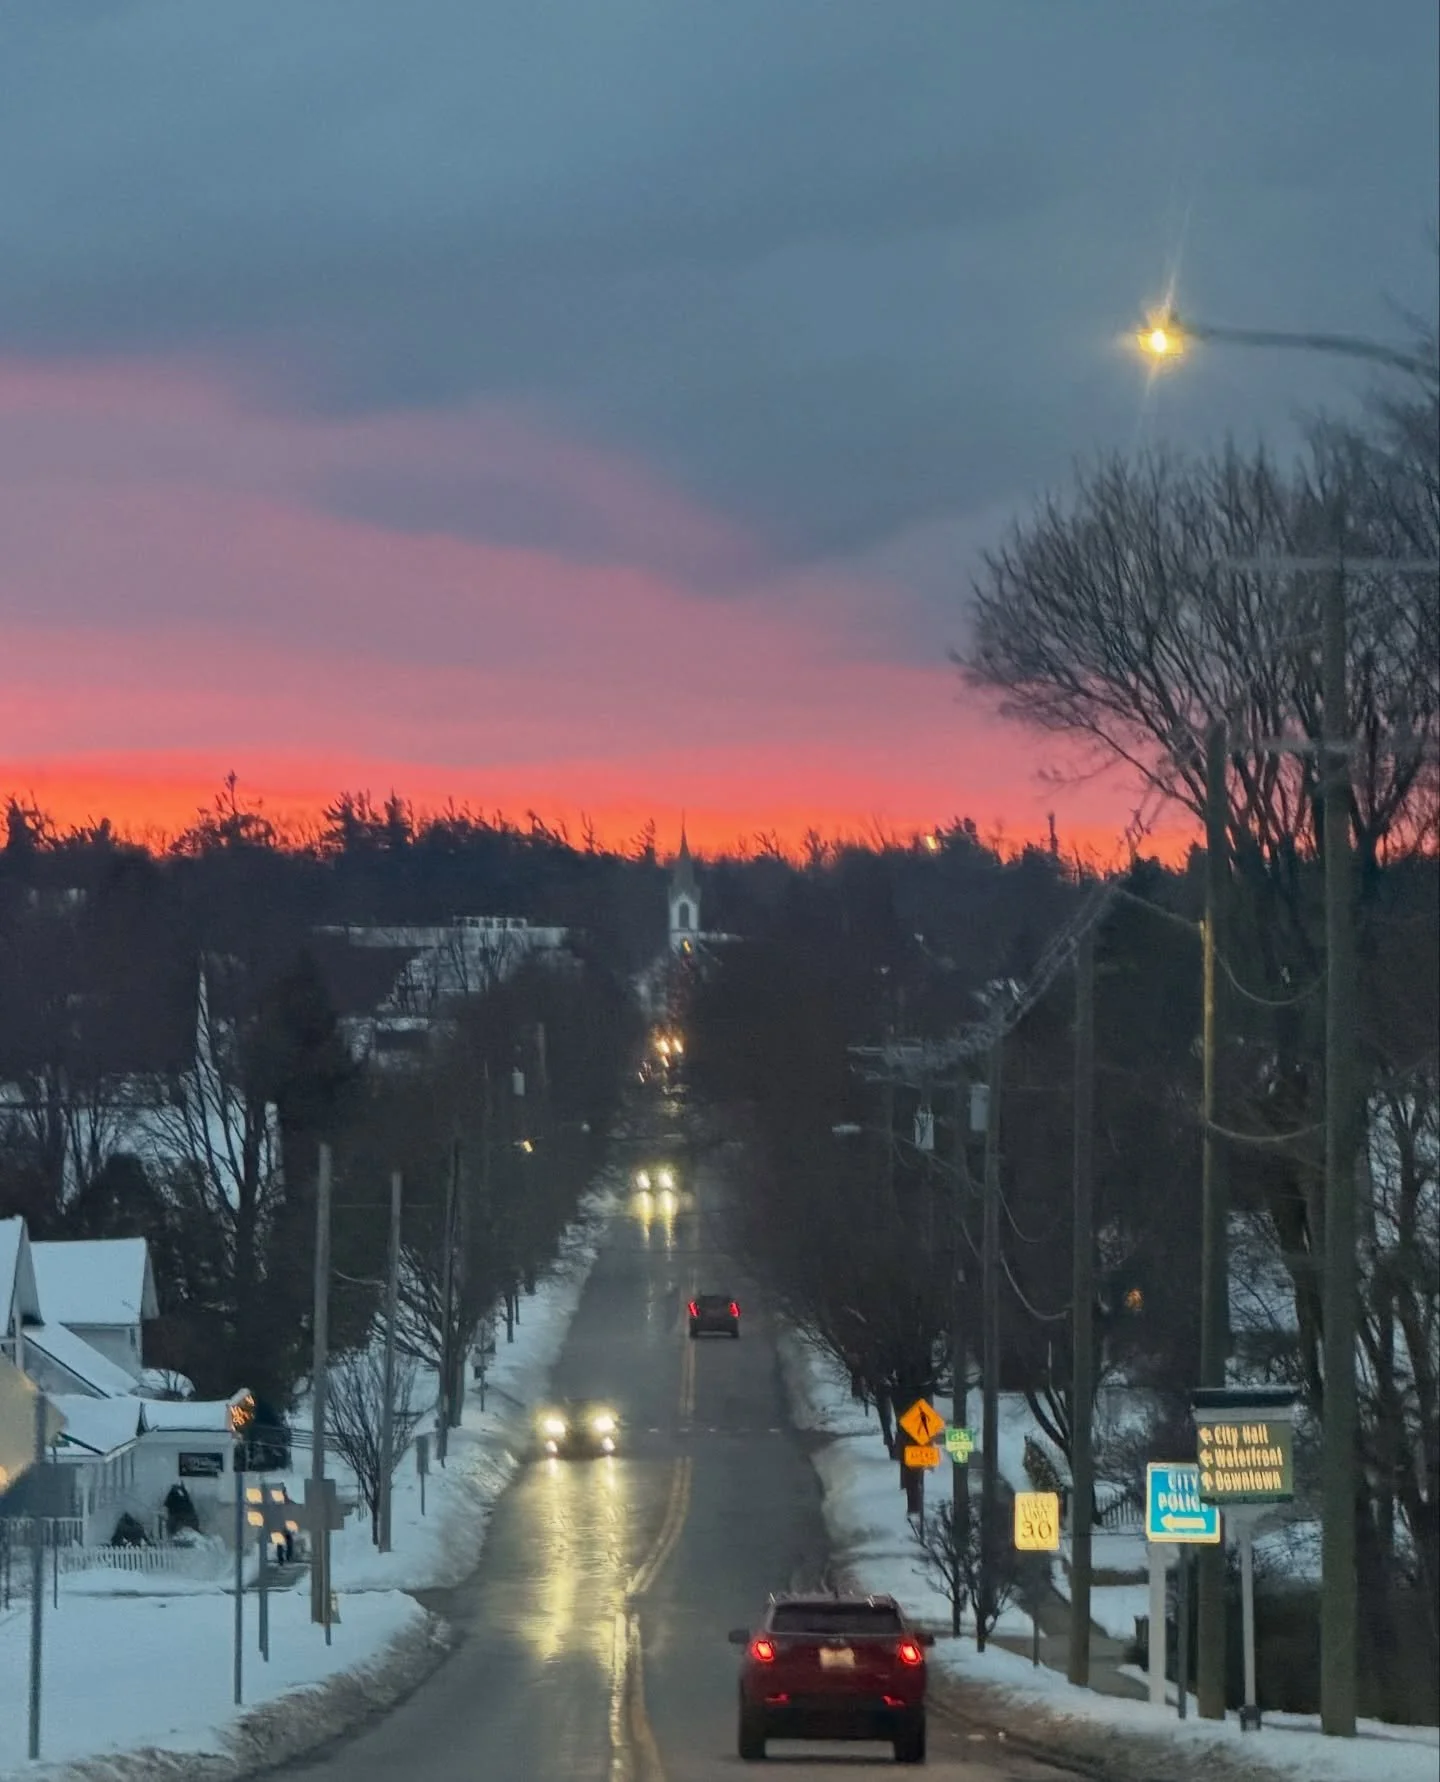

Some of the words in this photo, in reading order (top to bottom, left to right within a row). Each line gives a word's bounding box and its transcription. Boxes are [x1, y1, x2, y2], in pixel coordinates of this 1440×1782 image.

[1214, 1424, 1239, 1450] City
[1242, 1424, 1269, 1445] Hall
[1214, 1446, 1283, 1469] Waterfront
[1215, 1470, 1282, 1491] Downtown
[1021, 1520, 1052, 1539] 30
